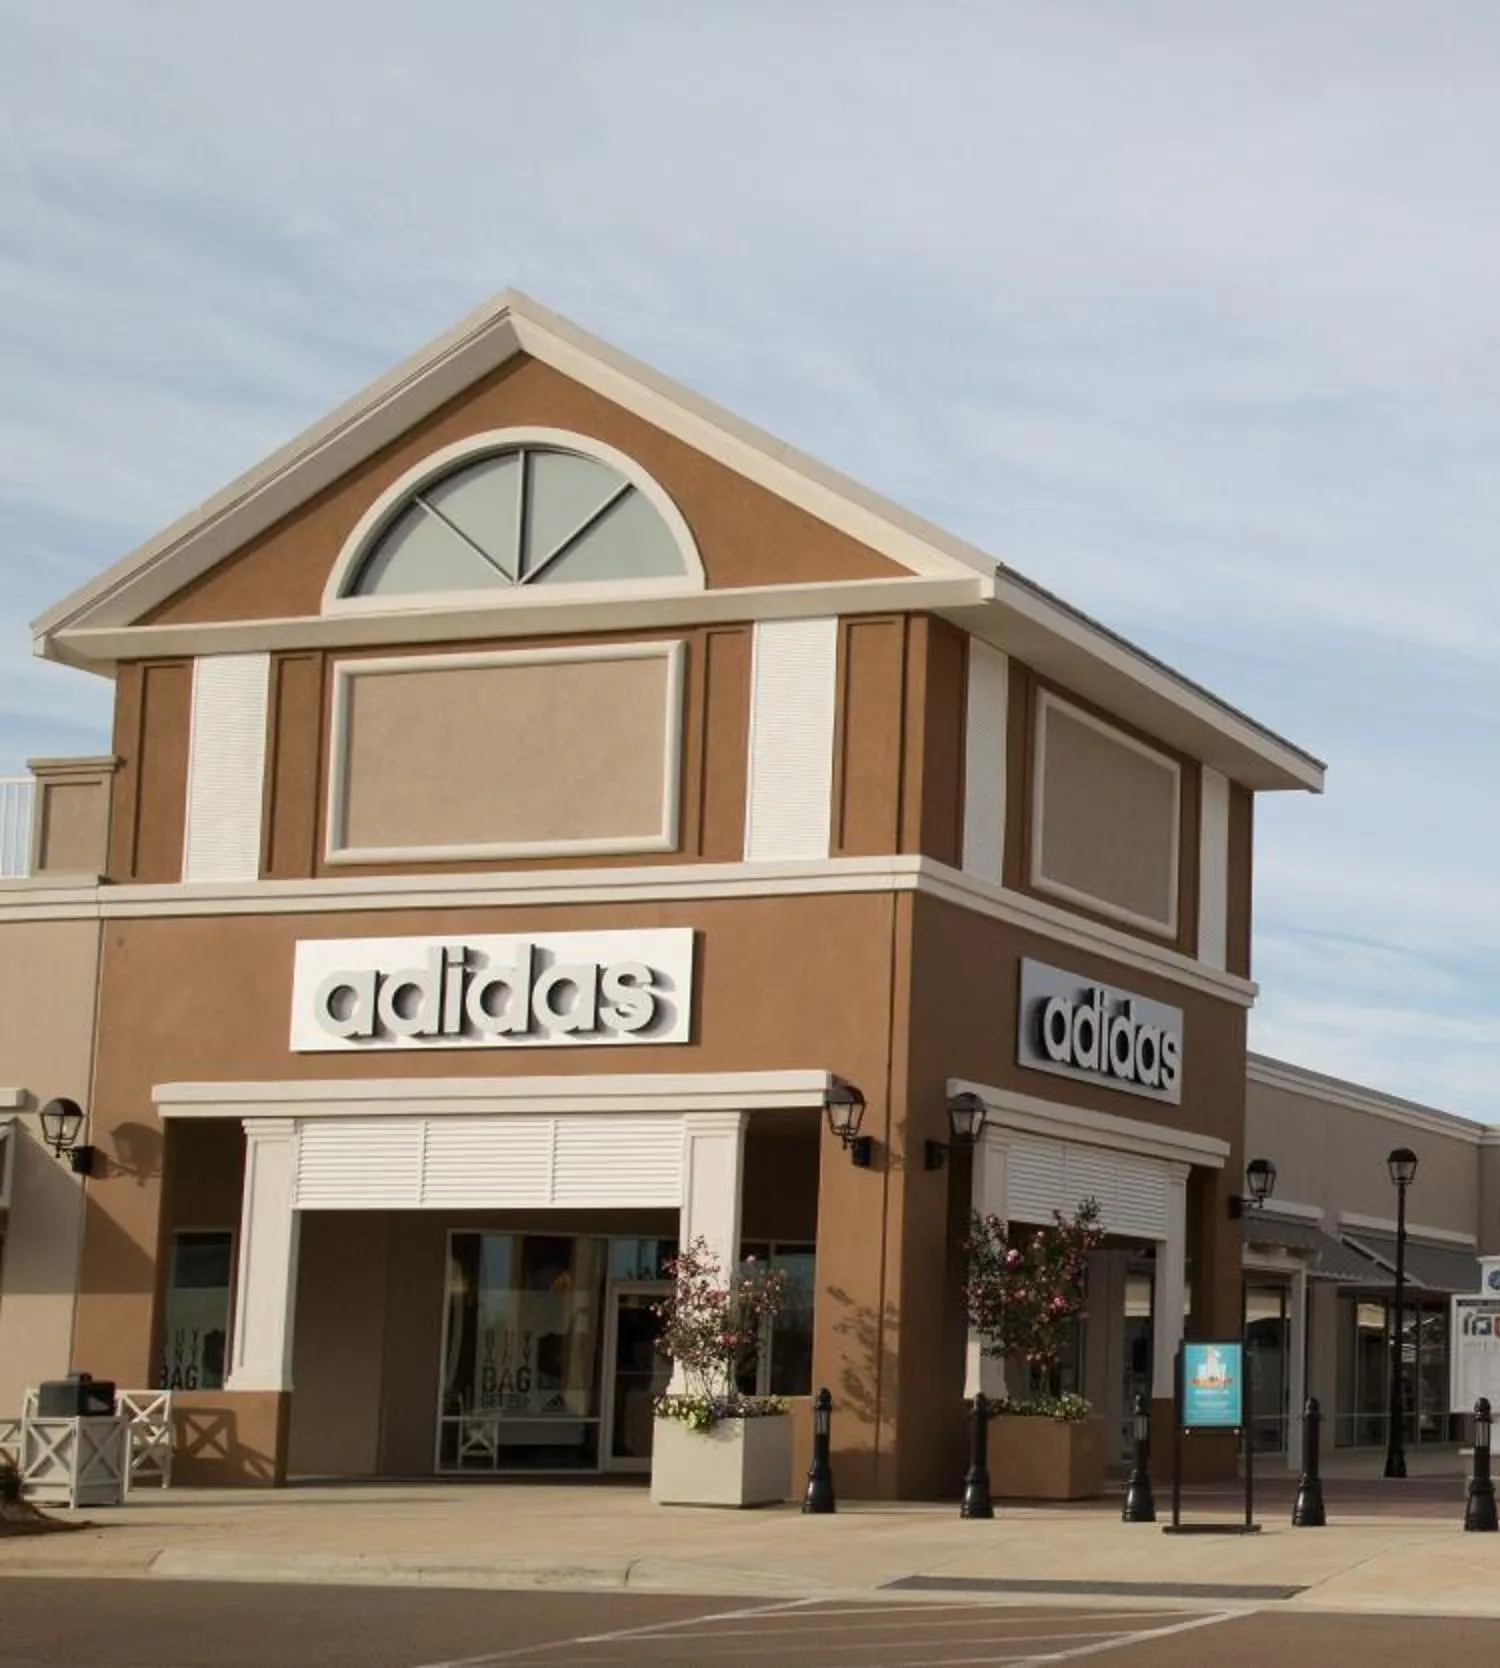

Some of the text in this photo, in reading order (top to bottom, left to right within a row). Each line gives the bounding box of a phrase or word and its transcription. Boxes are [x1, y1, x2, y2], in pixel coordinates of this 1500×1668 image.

[314, 944, 656, 1038] adidas
[1043, 987, 1177, 1089] adidas
[482, 1366, 532, 1393] BAG
